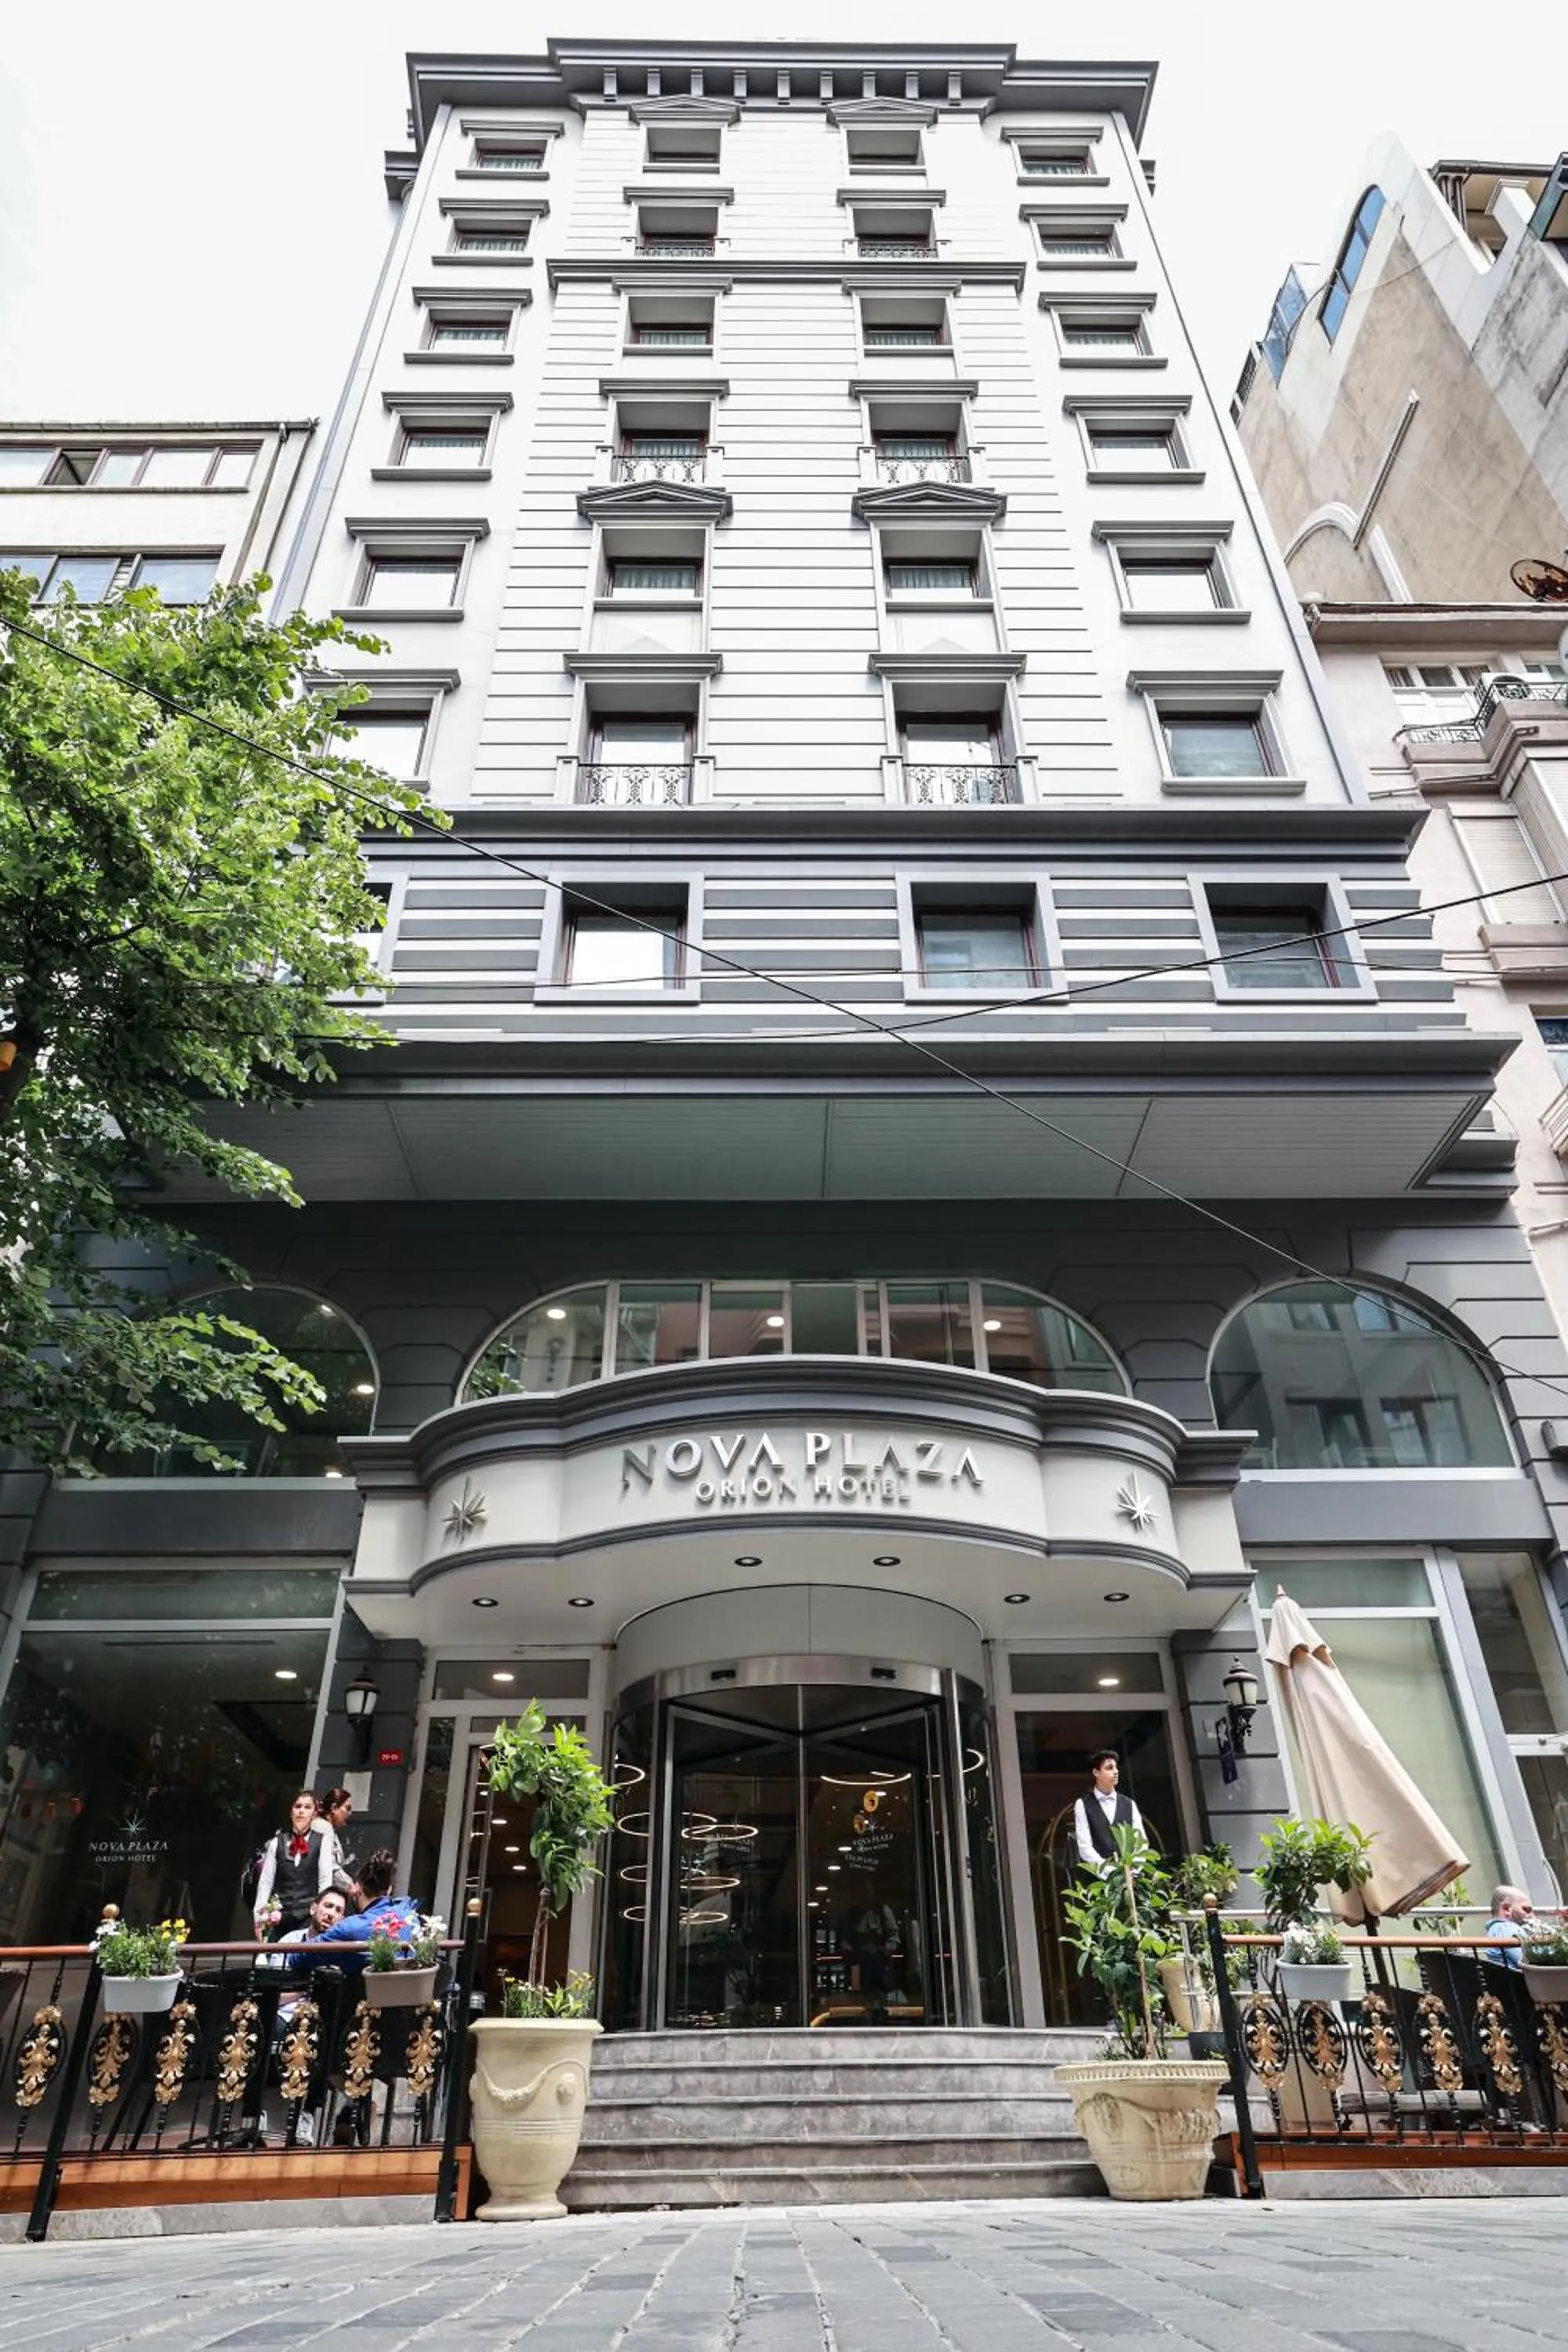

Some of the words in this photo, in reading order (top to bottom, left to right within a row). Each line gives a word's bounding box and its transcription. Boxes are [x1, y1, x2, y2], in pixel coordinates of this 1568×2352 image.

[622, 1432, 787, 1486] NOVA
[805, 1432, 985, 1487] PLAZA
[695, 1475, 797, 1505] ORION
[814, 1475, 912, 1504] HOTEL
[128, 1839, 169, 1851] PLAZA
